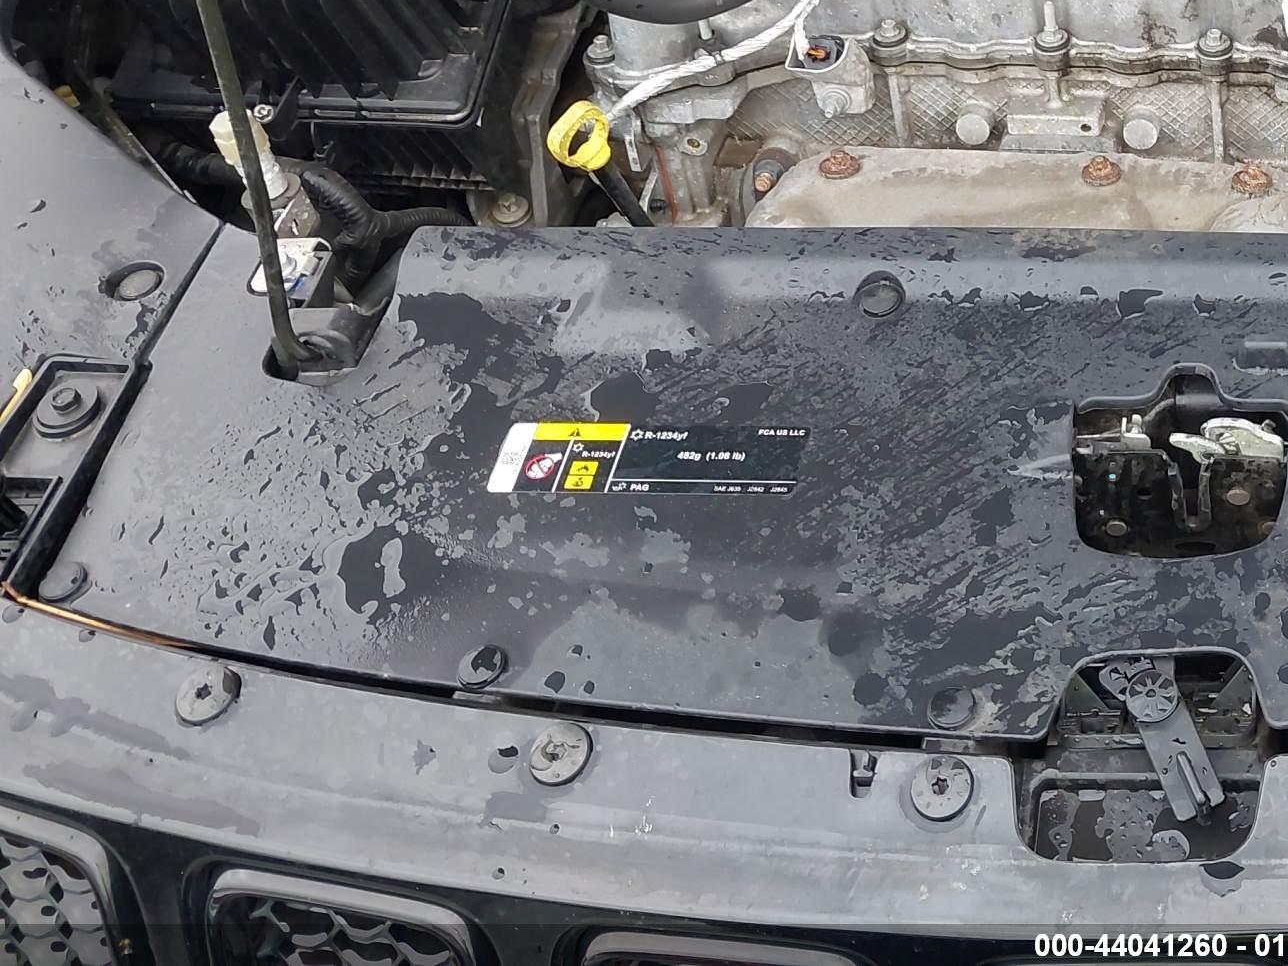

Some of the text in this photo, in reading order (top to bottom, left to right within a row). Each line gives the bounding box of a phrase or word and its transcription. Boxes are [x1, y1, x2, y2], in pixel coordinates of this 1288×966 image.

[644, 431, 688, 441] R-1234yf
[732, 452, 746, 461] lb)
[630, 483, 649, 491] PAG
